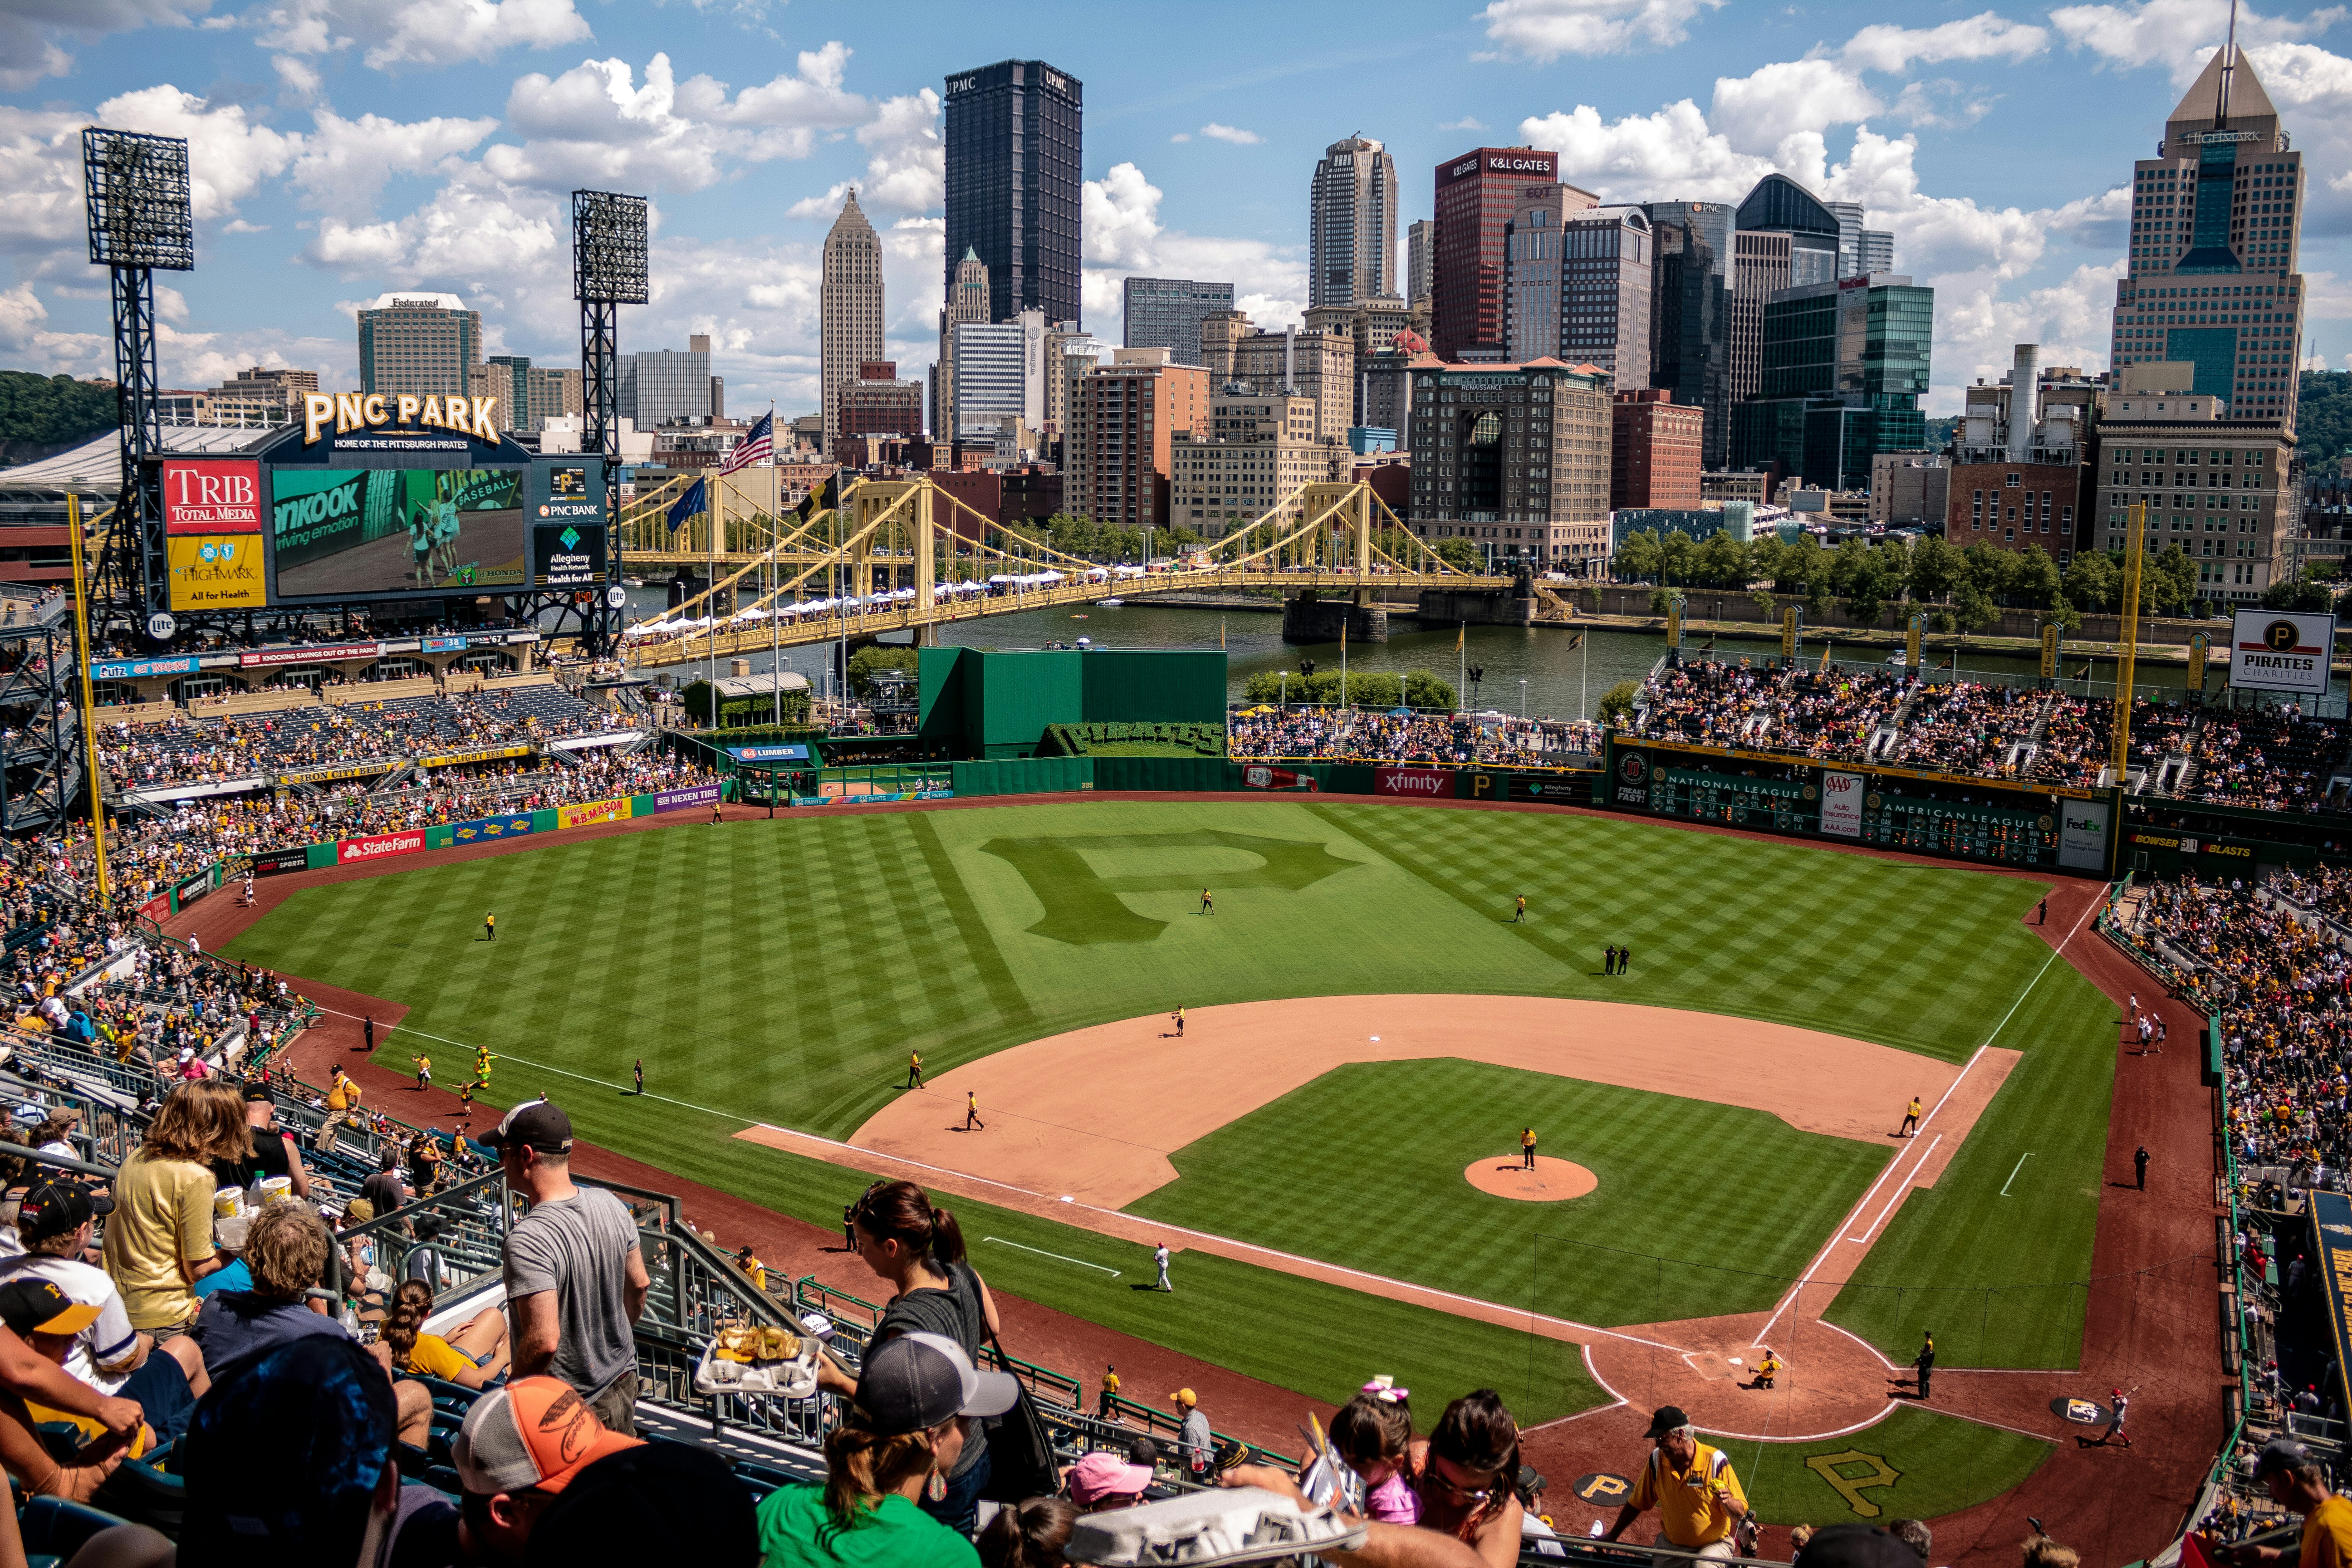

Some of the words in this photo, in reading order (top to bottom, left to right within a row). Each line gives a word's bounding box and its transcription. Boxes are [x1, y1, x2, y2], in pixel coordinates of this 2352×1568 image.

[945, 77, 975, 95] UPMC
[1046, 70, 1066, 92] UPMC
[2187, 131, 2260, 145] HIGHMARK
[1454, 166, 1462, 177] K&L
[1462, 159, 1477, 173] GATES
[1490, 157, 1511, 169] K&L
[1513, 159, 1550, 171] GATES
[1526, 186, 1551, 199] EQT
[1703, 205, 1720, 213] PNC
[303, 392, 389, 445] PNC
[397, 394, 501, 445] PARK
[334, 440, 358, 448] HOME
[388, 440, 436, 448] PITTSBURGH
[437, 441, 468, 449] PIRATES
[169, 469, 254, 505] TRIB
[459, 478, 514, 506] BASEBALL
[172, 507, 215, 521] TOTAL
[216, 507, 256, 520] MEDIA
[312, 515, 358, 539] emotion
[551, 554, 590, 564] Allegheny
[183, 567, 255, 581] HIGHMARK
[547, 574, 571, 583] Health
[572, 574, 582, 582] for
[582, 573, 593, 582] All
[191, 592, 203, 600] All
[220, 589, 250, 599] Health
[610, 592, 624, 603] Lite
[151, 618, 172, 632] Lite
[2046, 628, 2054, 653] Health
[2274, 627, 2289, 646] P
[133, 664, 150, 674] GET
[2244, 655, 2313, 671] PIRATES
[2244, 668, 2313, 680] CHARITIES
[455, 753, 483, 762] LIGHT
[486, 750, 505, 758] BEER
[758, 748, 794, 756] LUMBER
[1621, 754, 1633, 767] JIMMY
[299, 772, 328, 780] IRON
[331, 769, 355, 778] CITY
[359, 765, 387, 774] BEER
[1627, 761, 1640, 776] JJ
[1656, 769, 1663, 778] 21
[1386, 772, 1443, 793] xfinity
[1474, 775, 1490, 797] P
[1668, 775, 1739, 791] NATIONAL
[1745, 785, 1798, 799] LEAGUE
[1828, 776, 1850, 792] AAA
[671, 792, 698, 803] NEXEN
[700, 789, 717, 799] TIRE
[1617, 793, 1645, 803] FAST!
[1618, 787, 1647, 795] FREAKY
[2094, 788, 2110, 798] 320
[1869, 797, 1877, 805] 21
[1823, 809, 1860, 820] Insurance
[1884, 804, 1965, 820] AMERICAN
[1972, 814, 2034, 829] LEAGUE
[1824, 823, 1858, 833] AAA.com
[2041, 818, 2049, 826] 21
[2066, 818, 2101, 832] FedEx
[2064, 843, 2086, 852] Pittsburgh
[2135, 835, 2179, 848] BOWSER
[2208, 844, 2251, 857] BLASTS
[258, 862, 278, 871] ROOT
[279, 859, 305, 868] SPORTS
[152, 898, 168, 911] TOTAL
[155, 909, 170, 921] MEDIA
[2332, 1248, 2352, 1271] PARK
[1581, 1475, 1627, 1498] P
[1804, 1448, 1903, 1518] P
